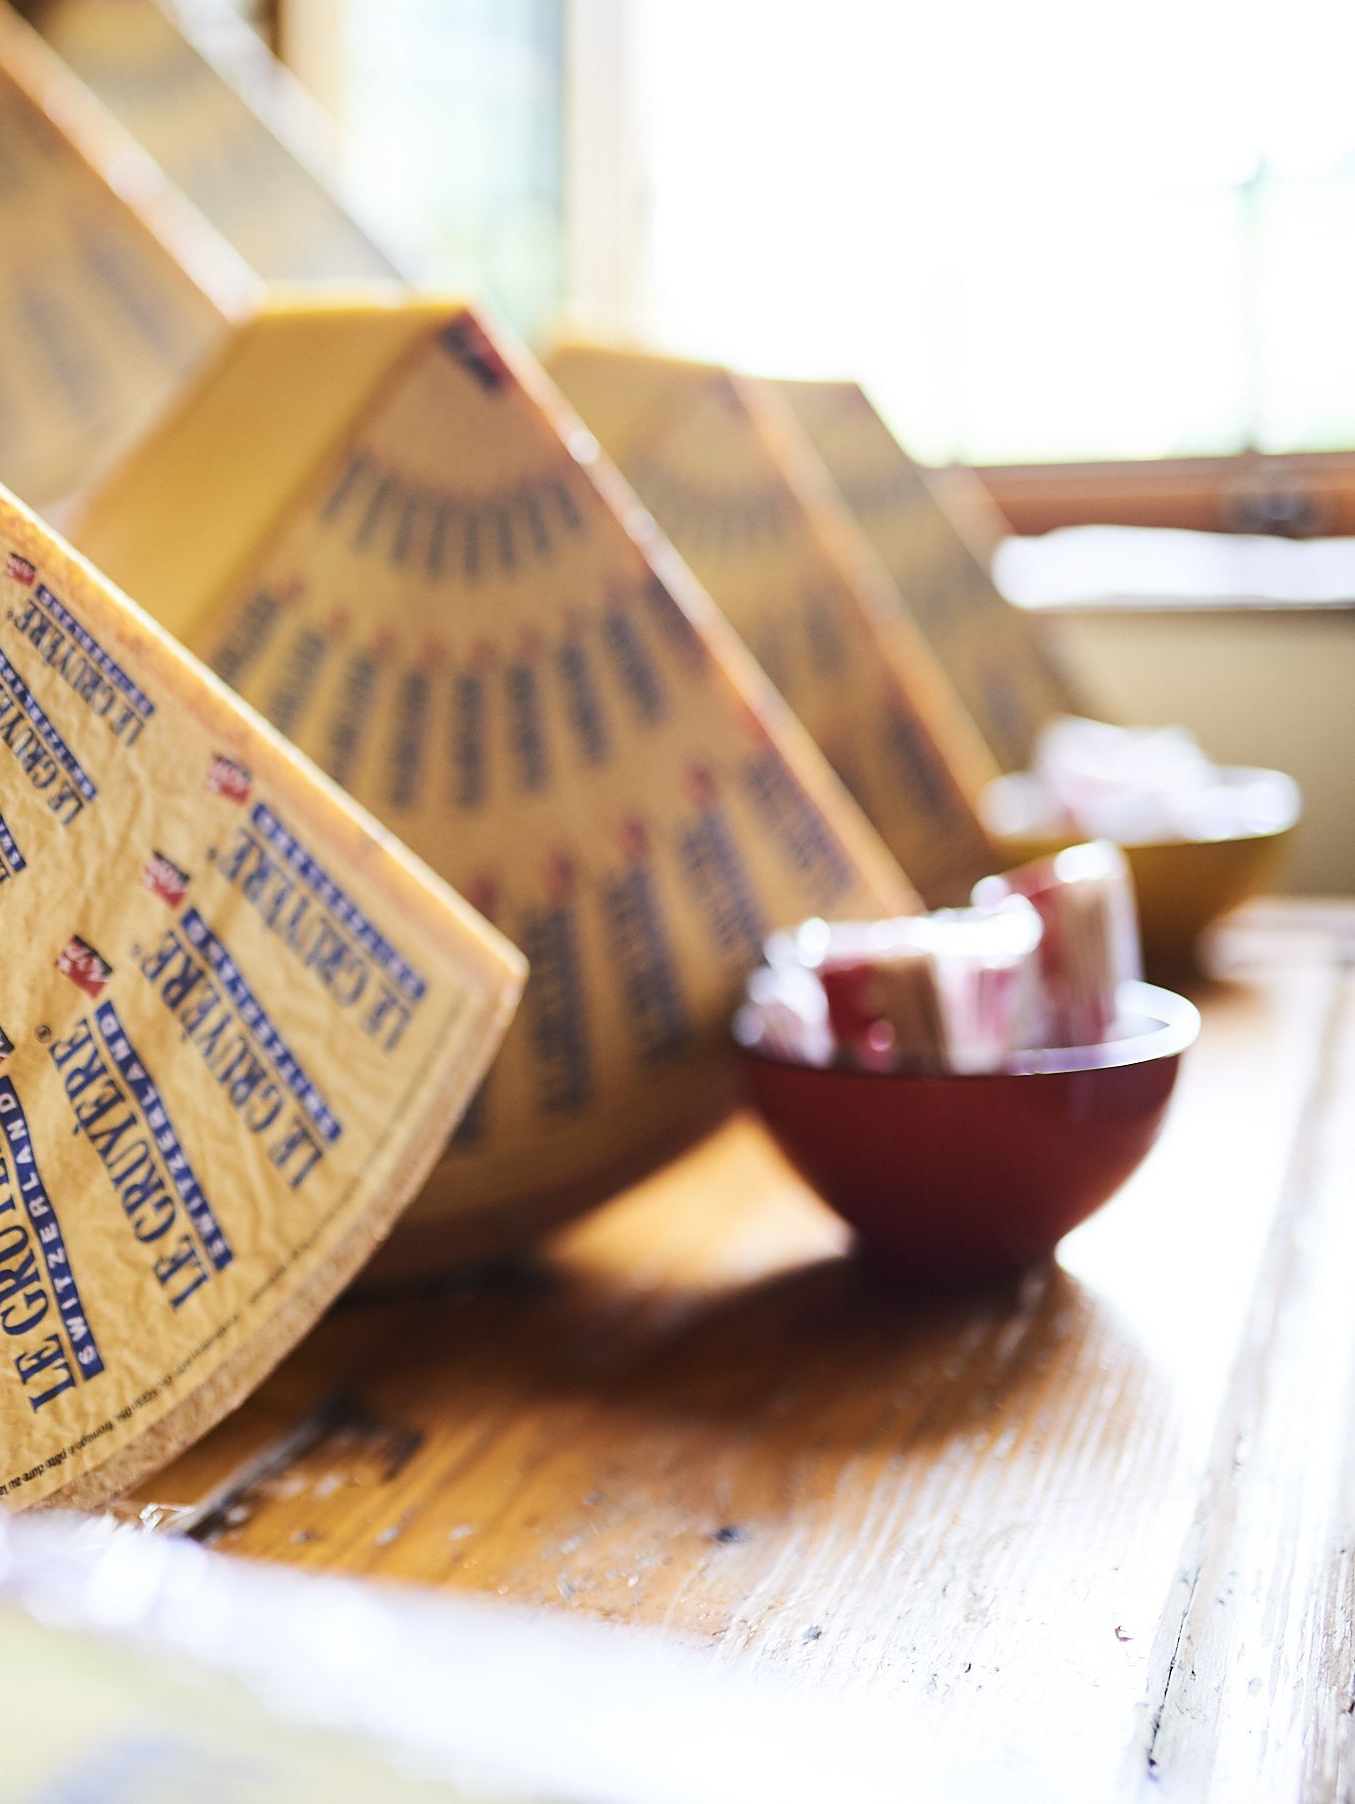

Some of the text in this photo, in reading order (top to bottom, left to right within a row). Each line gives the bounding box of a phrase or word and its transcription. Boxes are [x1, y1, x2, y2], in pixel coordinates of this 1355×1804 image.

[0, 1092, 97, 1365] SWITZERLAND
[152, 1234, 212, 1312] LE
[15, 1334, 77, 1412] LE
